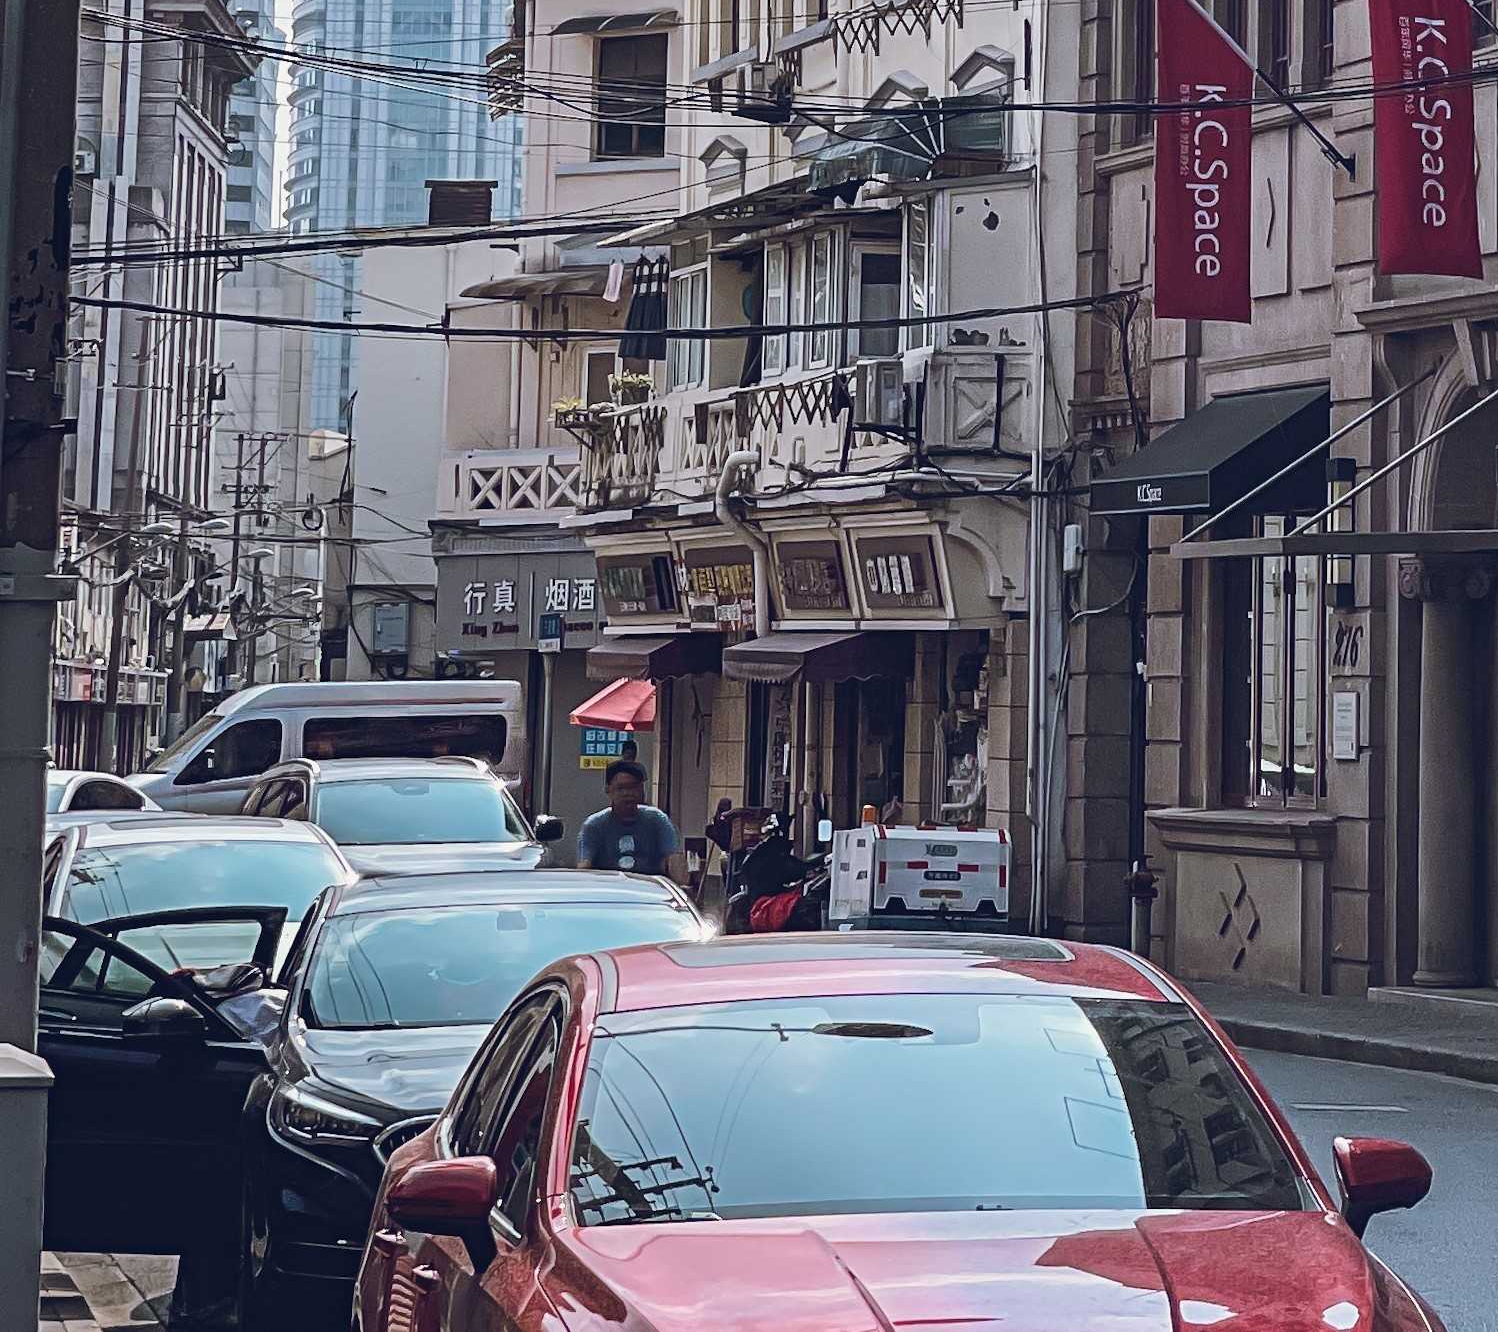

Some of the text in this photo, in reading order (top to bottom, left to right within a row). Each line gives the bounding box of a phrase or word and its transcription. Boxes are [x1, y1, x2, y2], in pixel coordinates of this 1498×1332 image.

[1186, 84, 1229, 276] K.C.Space
[1412, 17, 1451, 227] K.C.Space
[464, 579, 516, 615] 行真
[545, 578, 596, 611] 烟酒
